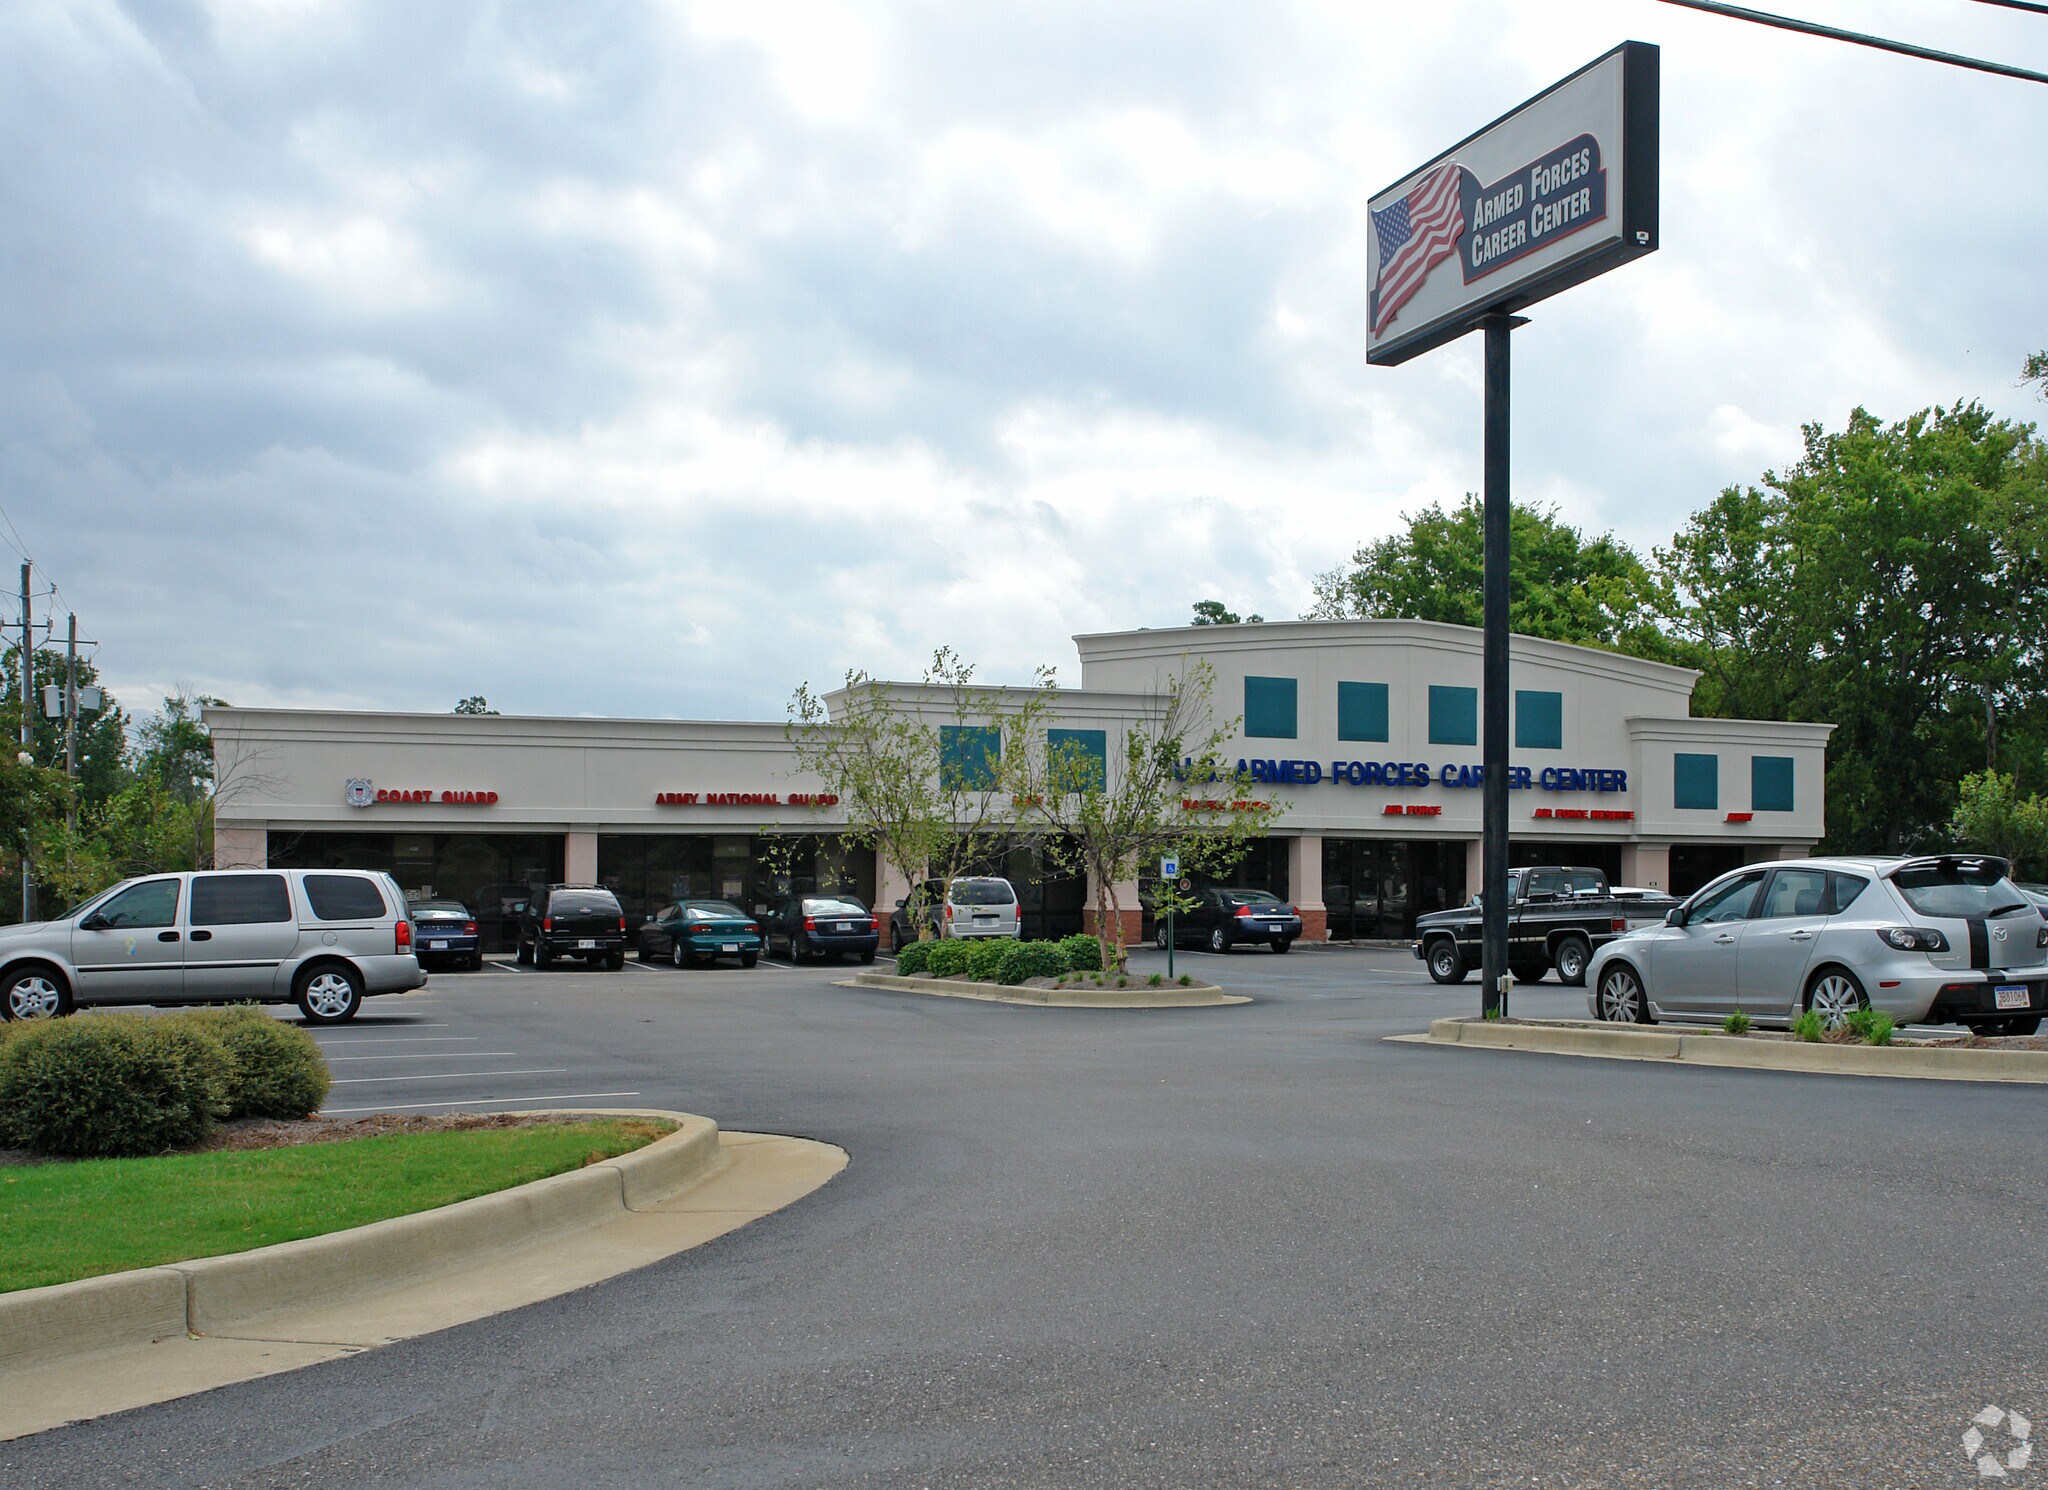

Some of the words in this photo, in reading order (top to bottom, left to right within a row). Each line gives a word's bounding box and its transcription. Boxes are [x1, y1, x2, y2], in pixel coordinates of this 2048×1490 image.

[1472, 183, 1524, 232] ARMED
[1530, 147, 1590, 202] FORCES
[1471, 219, 1527, 268] CAREER
[1530, 187, 1591, 238] CENTER
[1235, 758, 1322, 785] ARMED
[1331, 760, 1431, 787] FORCES
[1439, 763, 1532, 790] CARER
[1539, 766, 1628, 792] CENTER
[376, 789, 433, 803] COAST
[441, 790, 499, 804] GUARD
[655, 792, 699, 804] ARMY
[706, 792, 782, 805] NATIONAL
[1406, 805, 1442, 816] FORCE
